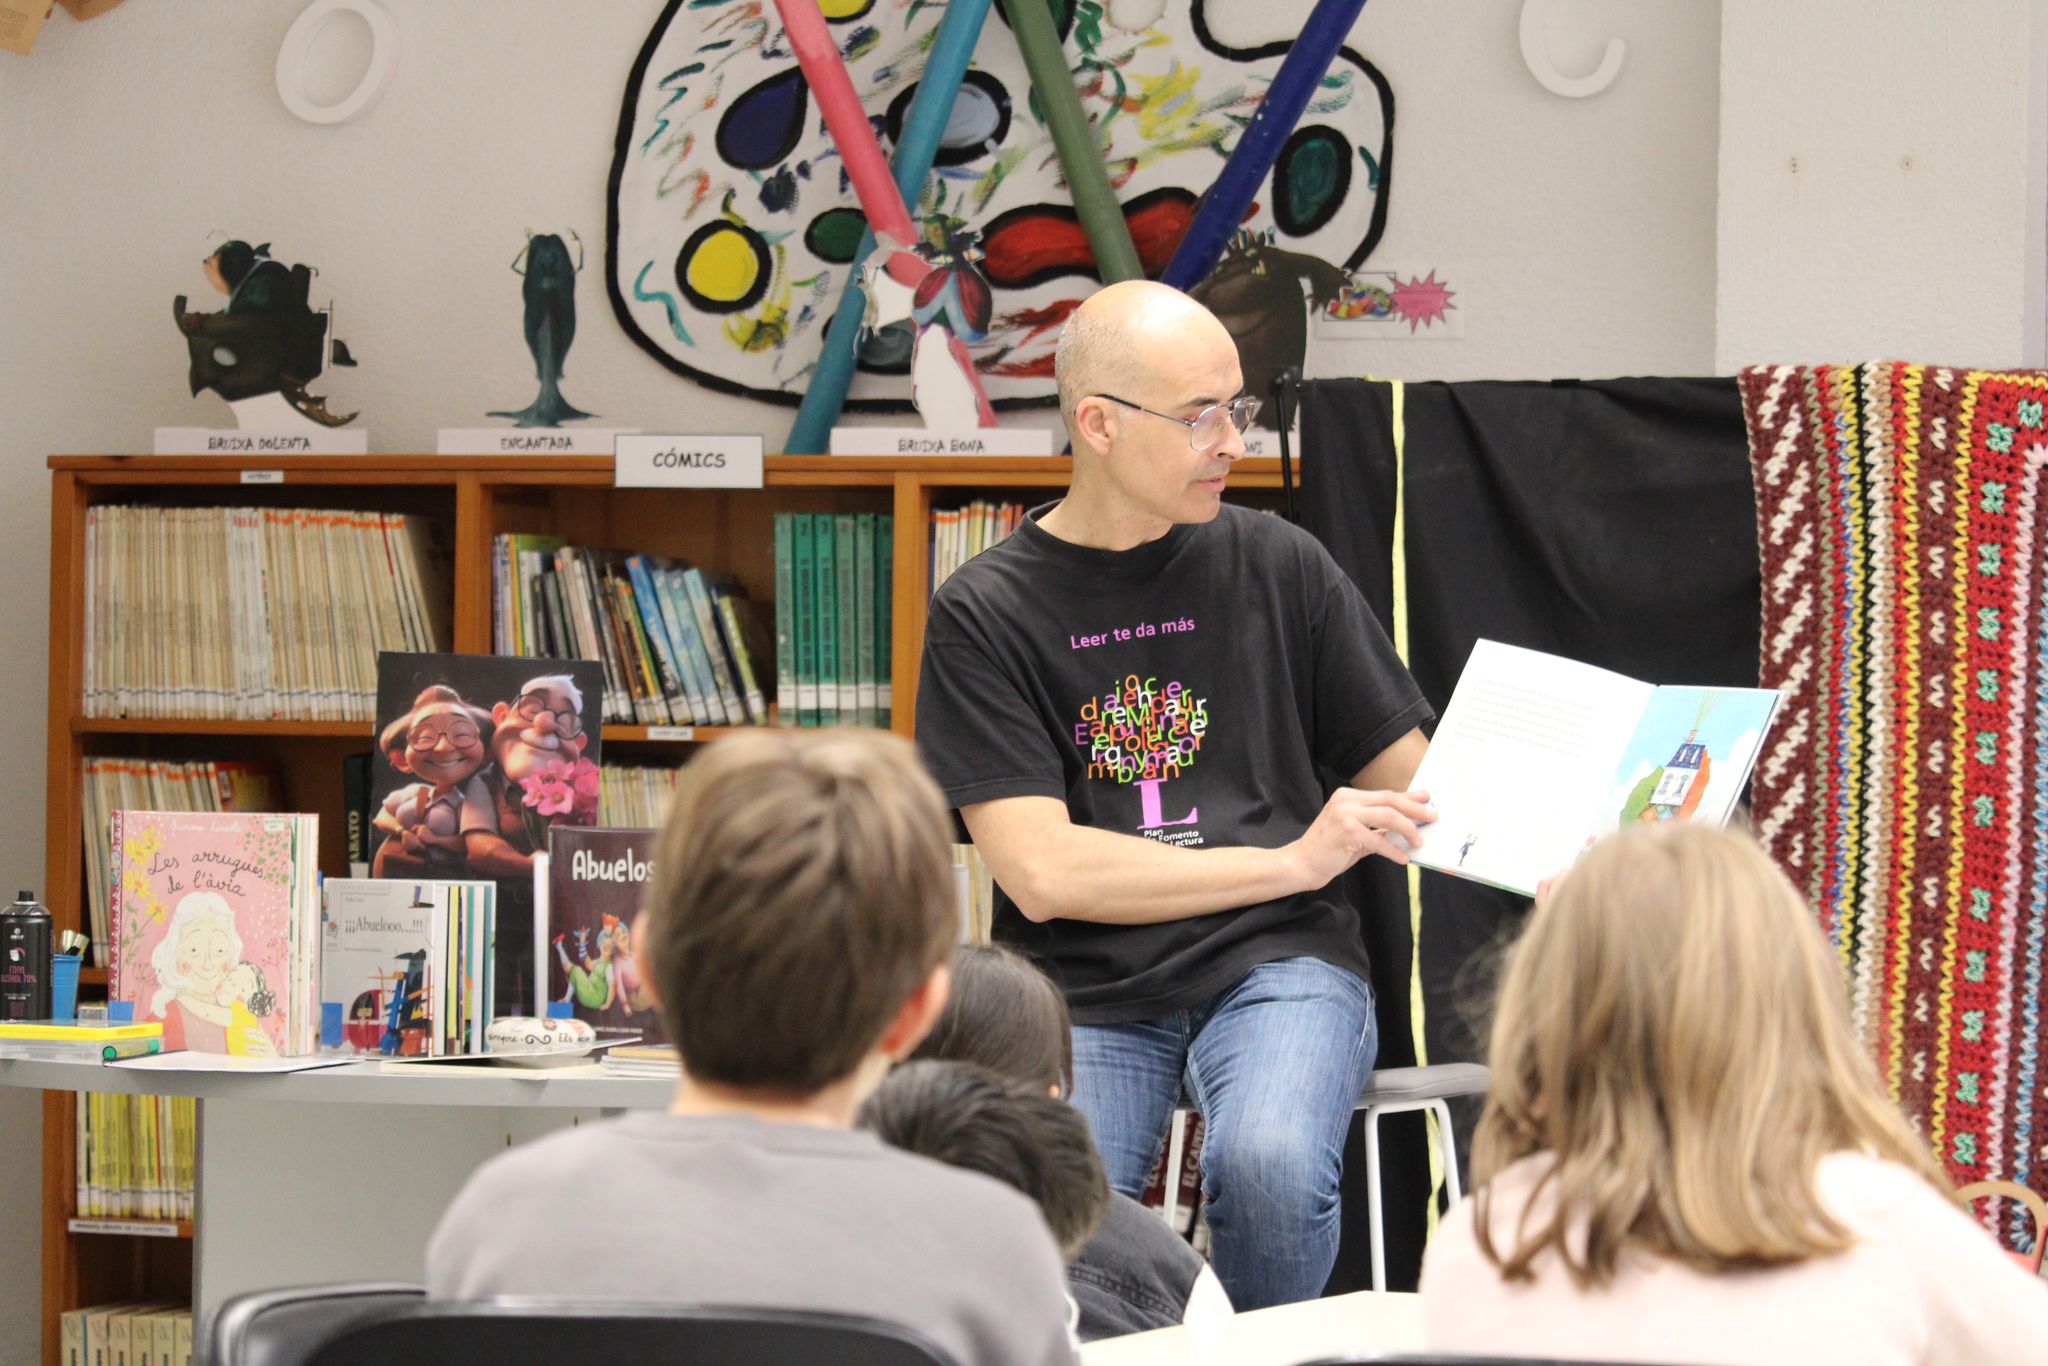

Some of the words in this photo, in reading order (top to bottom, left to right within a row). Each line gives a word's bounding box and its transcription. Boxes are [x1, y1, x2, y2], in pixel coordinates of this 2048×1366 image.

[208, 437, 252, 450] BRUIXA
[259, 437, 311, 450] DOLENTA
[500, 437, 573, 450] ENCANTADA
[898, 438, 945, 454] BRUIXA
[950, 438, 985, 453] BONA
[653, 447, 727, 469] CÓMICS
[1070, 633, 1108, 650] Leer
[1113, 628, 1131, 642] te
[1136, 622, 1156, 638] da
[1161, 616, 1196, 634] más
[1143, 829, 1164, 838] Plan
[1158, 830, 1199, 842] Fomento
[147, 851, 180, 876] Les
[192, 851, 263, 878] arrugues
[167, 874, 184, 894] de
